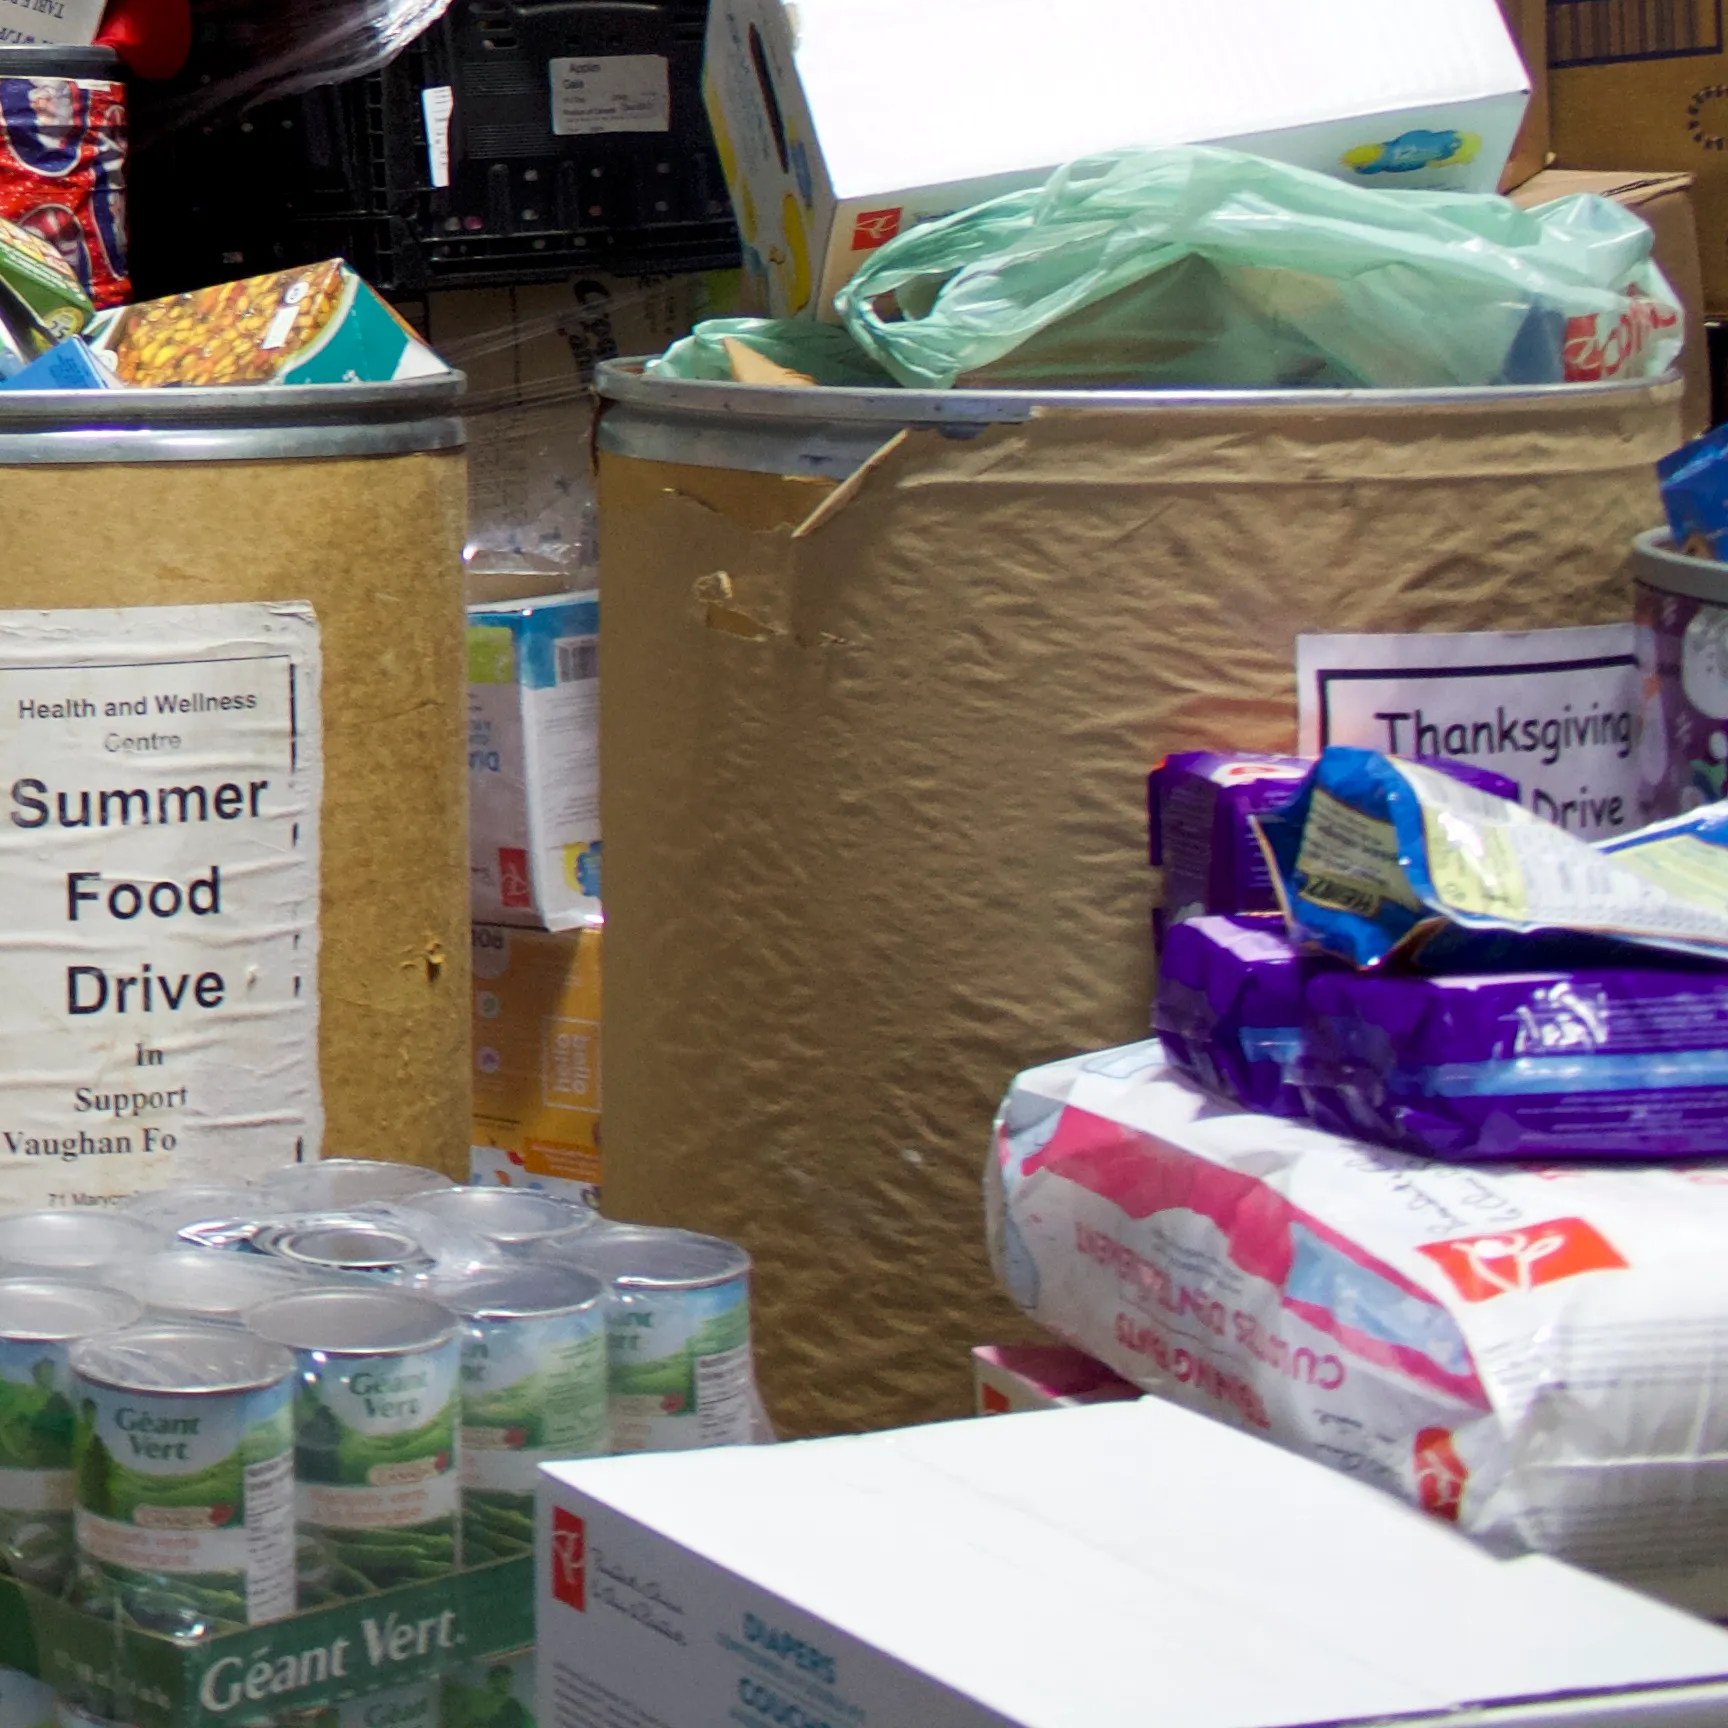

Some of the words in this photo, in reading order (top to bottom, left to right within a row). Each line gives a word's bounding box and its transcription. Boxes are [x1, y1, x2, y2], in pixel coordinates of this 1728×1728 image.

[19, 699, 96, 719] Health
[105, 698, 148, 717] and
[155, 693, 257, 714] Wellness
[105, 732, 181, 752] Centre
[1375, 704, 1634, 763] Thanksgiving
[11, 778, 268, 829] Summer
[67, 866, 221, 921] Food
[67, 964, 225, 1015] Drive
[136, 1043, 163, 1067] In
[74, 1085, 189, 1118] Support
[3, 1130, 131, 1161] Vaughan
[115, 1408, 200, 1436] Géant
[130, 1436, 190, 1461] Vert
[200, 1637, 349, 1712] Géant
